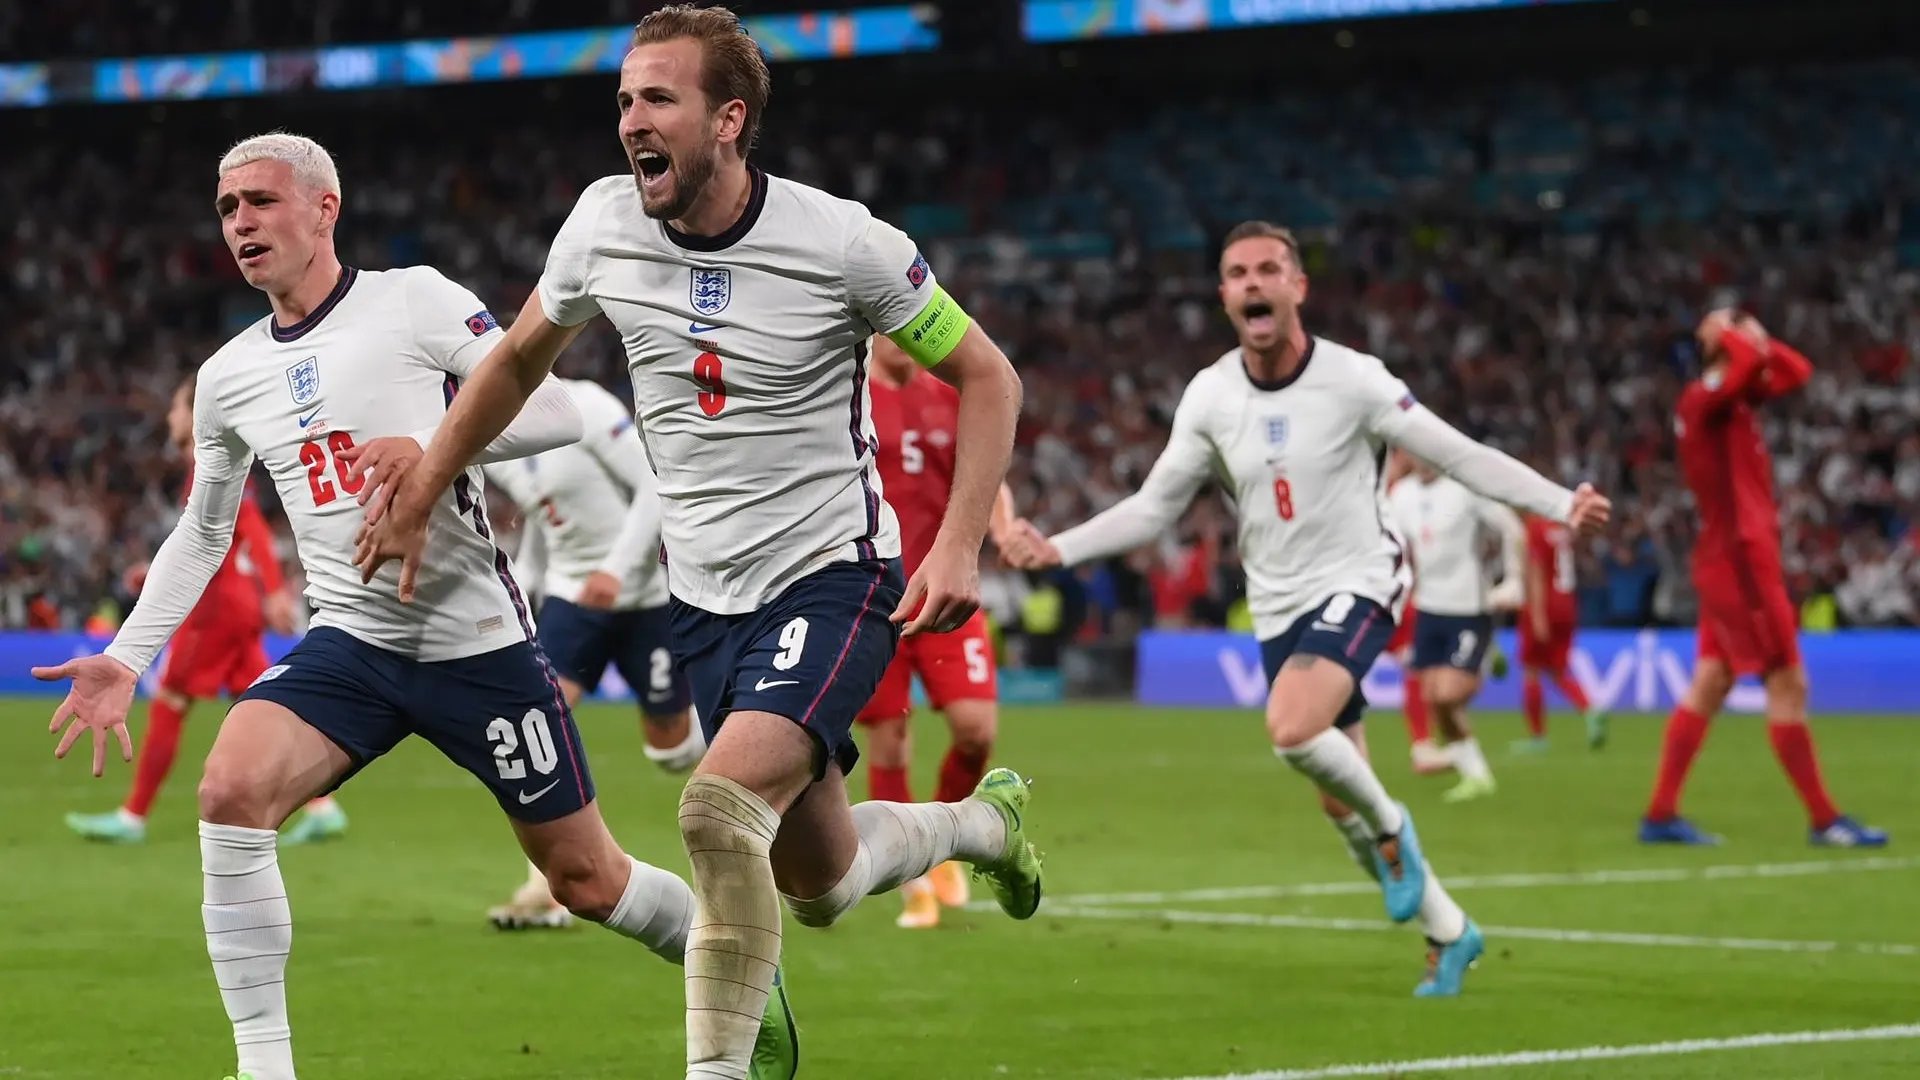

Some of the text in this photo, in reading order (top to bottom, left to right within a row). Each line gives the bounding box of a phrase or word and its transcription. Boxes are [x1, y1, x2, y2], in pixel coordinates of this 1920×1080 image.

[693, 351, 726, 416] 9
[902, 430, 924, 473] 5
[1273, 478, 1293, 520] 8
[772, 616, 809, 671] 9
[963, 637, 988, 683] 5
[650, 648, 672, 689] 2
[486, 708, 559, 779] 20
